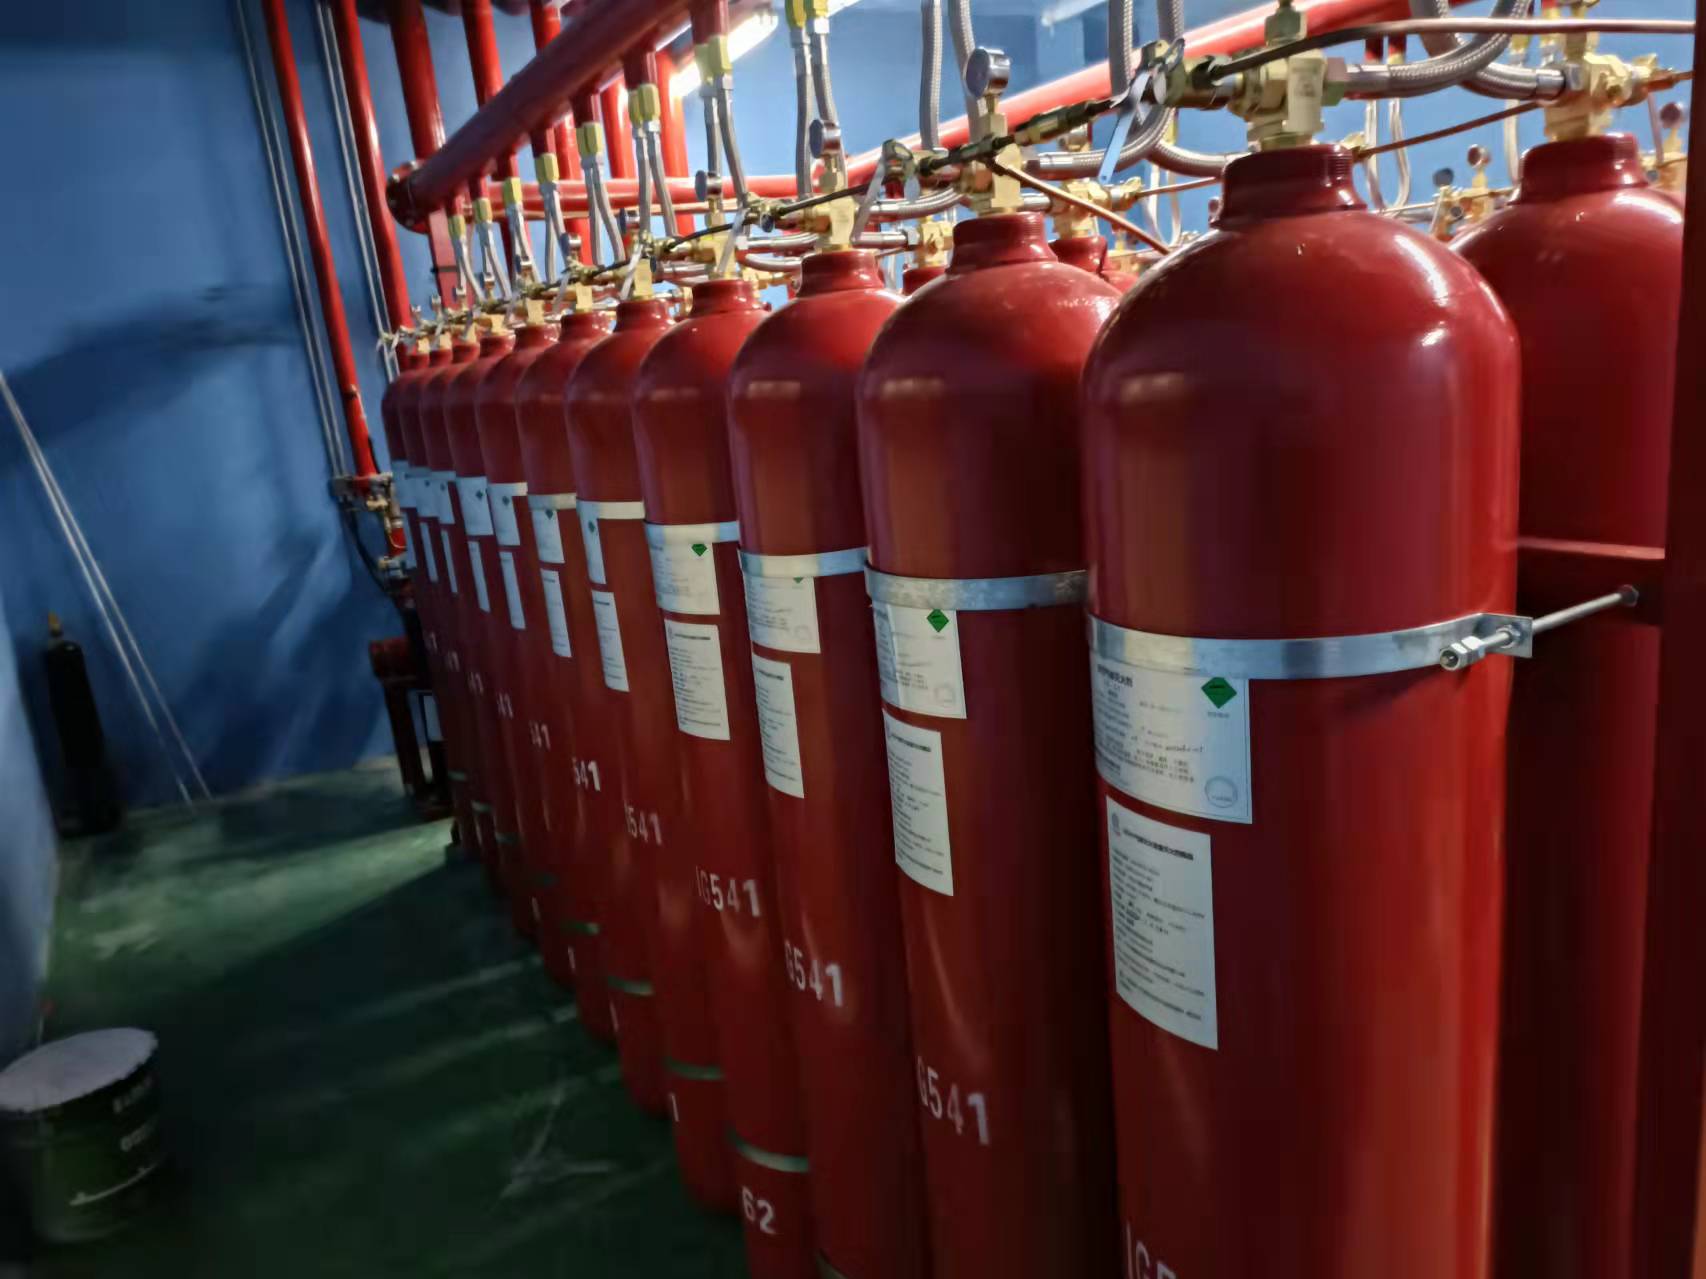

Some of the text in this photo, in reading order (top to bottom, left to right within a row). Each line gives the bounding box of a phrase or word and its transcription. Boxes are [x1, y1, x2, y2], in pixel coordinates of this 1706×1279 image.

[695, 864, 761, 917] IG541
[742, 1185, 776, 1235] 62
[1126, 1219, 1177, 1279] IG
